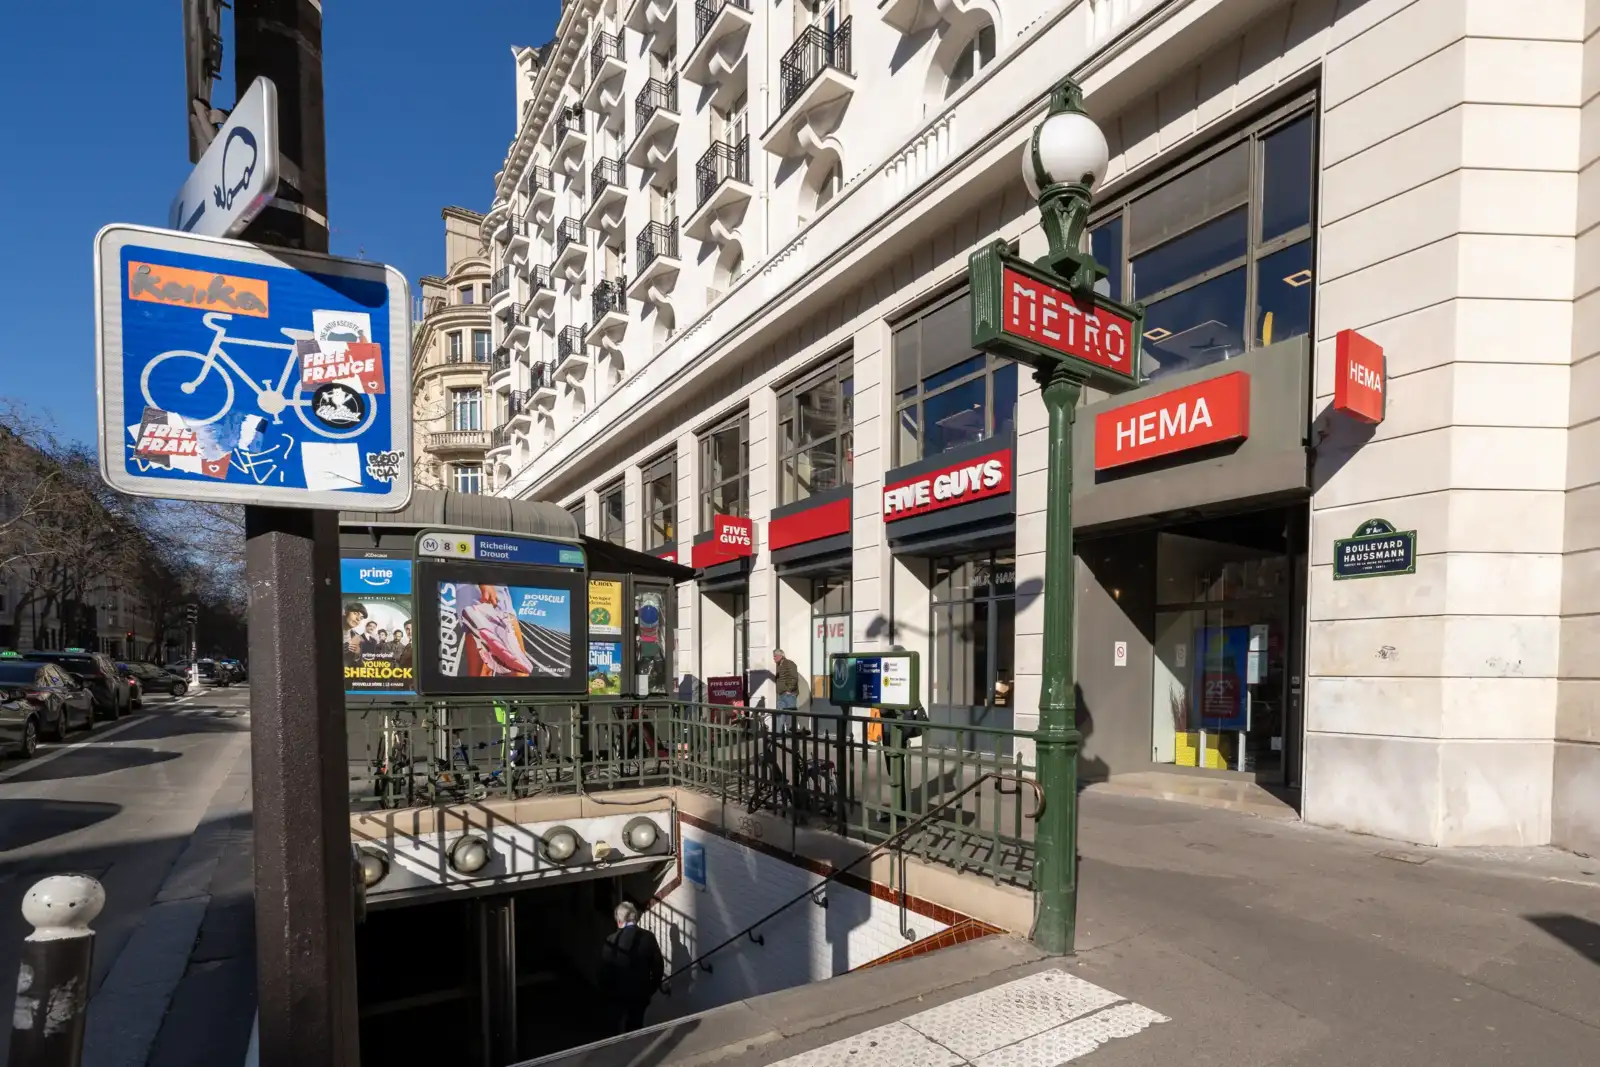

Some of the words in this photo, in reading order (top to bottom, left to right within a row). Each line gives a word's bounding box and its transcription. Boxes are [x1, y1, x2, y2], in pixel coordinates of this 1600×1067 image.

[325, 320, 359, 334] ANTIFASCISTE
[1013, 282, 1125, 362] METRO
[304, 351, 345, 368] FREE
[303, 359, 376, 382] FRANCE
[1350, 360, 1382, 393] HEMA
[142, 423, 196, 439] FREE
[1116, 397, 1213, 451] HEMA
[884, 480, 930, 514] FIVE
[933, 460, 1003, 501] GUYS
[723, 525, 748, 536] FIVE
[444, 542, 451, 551] 8
[460, 544, 467, 552] 9
[480, 541, 519, 551] Richelieu
[720, 534, 751, 546] GUYS
[1345, 540, 1403, 554] BOULEVARD
[480, 550, 510, 559] Drouot
[1344, 549, 1405, 563] HAUSSMANN
[360, 567, 393, 580] prime
[524, 594, 565, 604] BOUSCULE
[440, 583, 458, 677] BROOKS
[817, 623, 845, 639] FIVE
[363, 660, 391, 668] YOUNG
[589, 651, 613, 666] Ghibli
[344, 667, 413, 679] SHERLOCK
